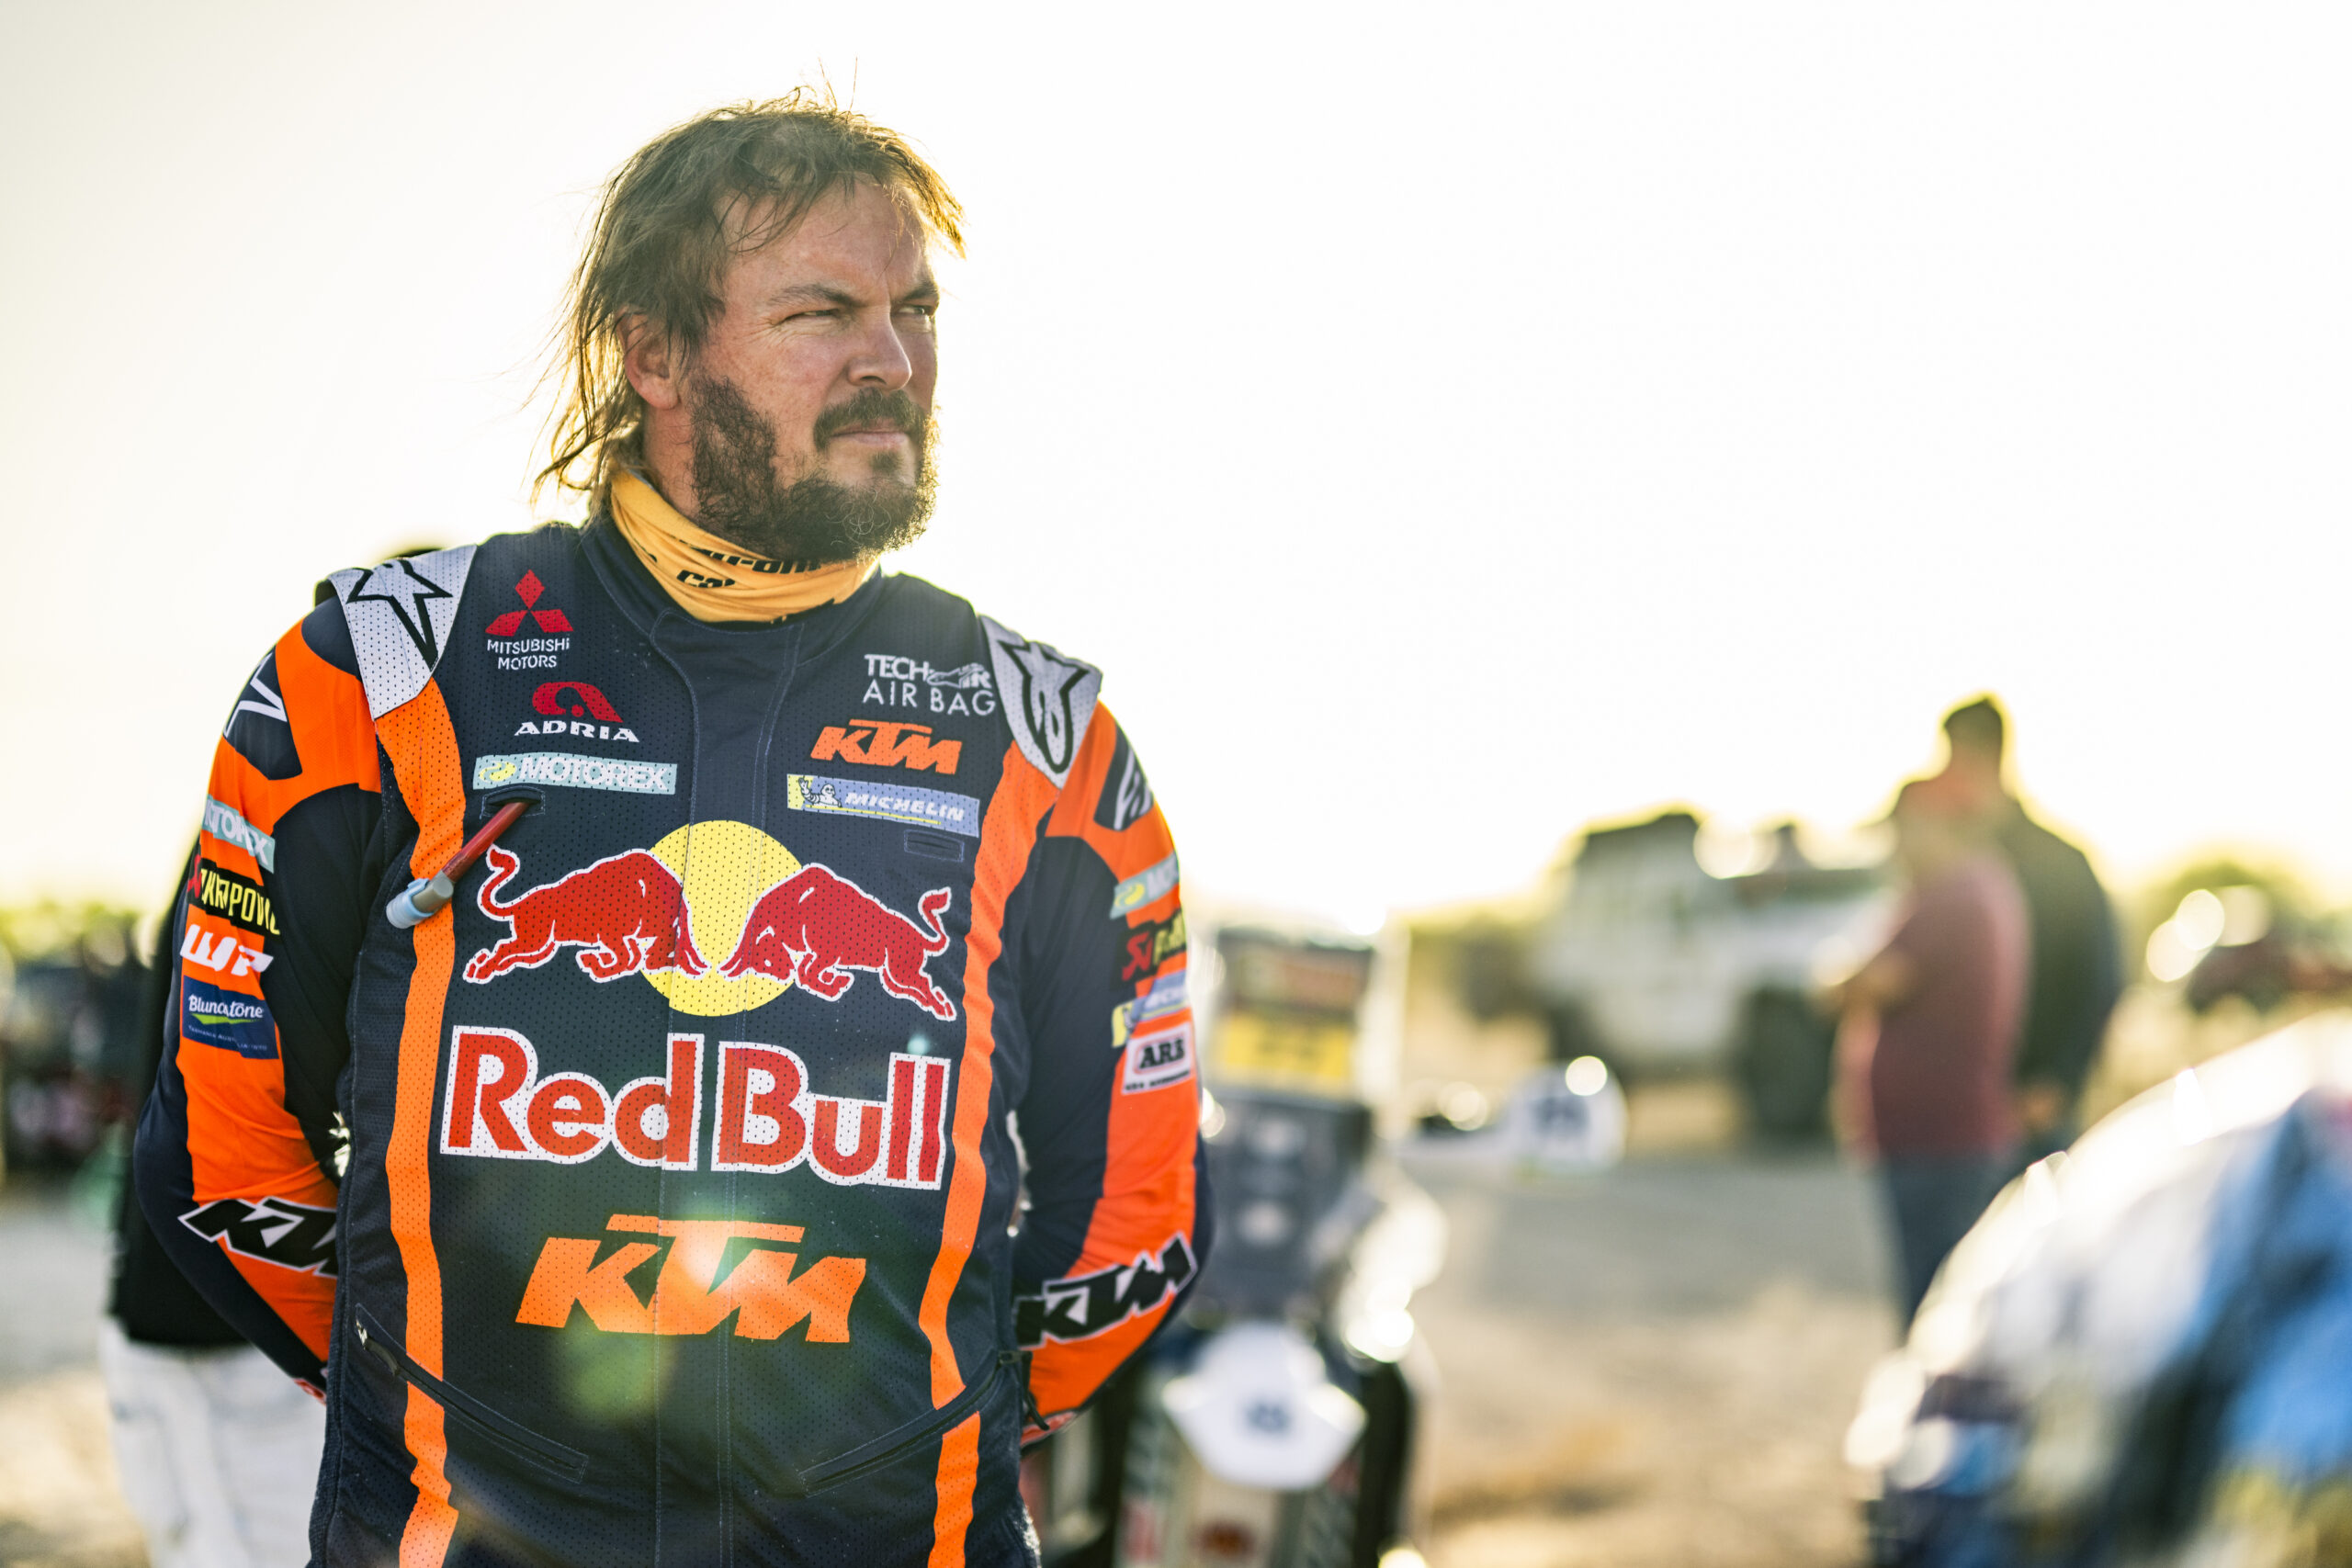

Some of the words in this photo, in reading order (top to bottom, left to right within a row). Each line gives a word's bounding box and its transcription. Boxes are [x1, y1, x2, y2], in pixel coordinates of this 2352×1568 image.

[487, 637, 571, 655] MITSUBISHI
[497, 655, 558, 671] MOTORS
[862, 679, 918, 708] AIR
[930, 687, 996, 716] BAG
[514, 720, 640, 743] ADRIA
[810, 719, 963, 775] KTM
[517, 756, 670, 791] MOTOREX
[844, 793, 965, 822] MICHELIN
[440, 1025, 706, 1171] Red
[710, 1041, 952, 1190] Bull
[177, 1195, 338, 1278] KT
[515, 1213, 866, 1343] KTM
[1012, 1231, 1198, 1351] KTM
